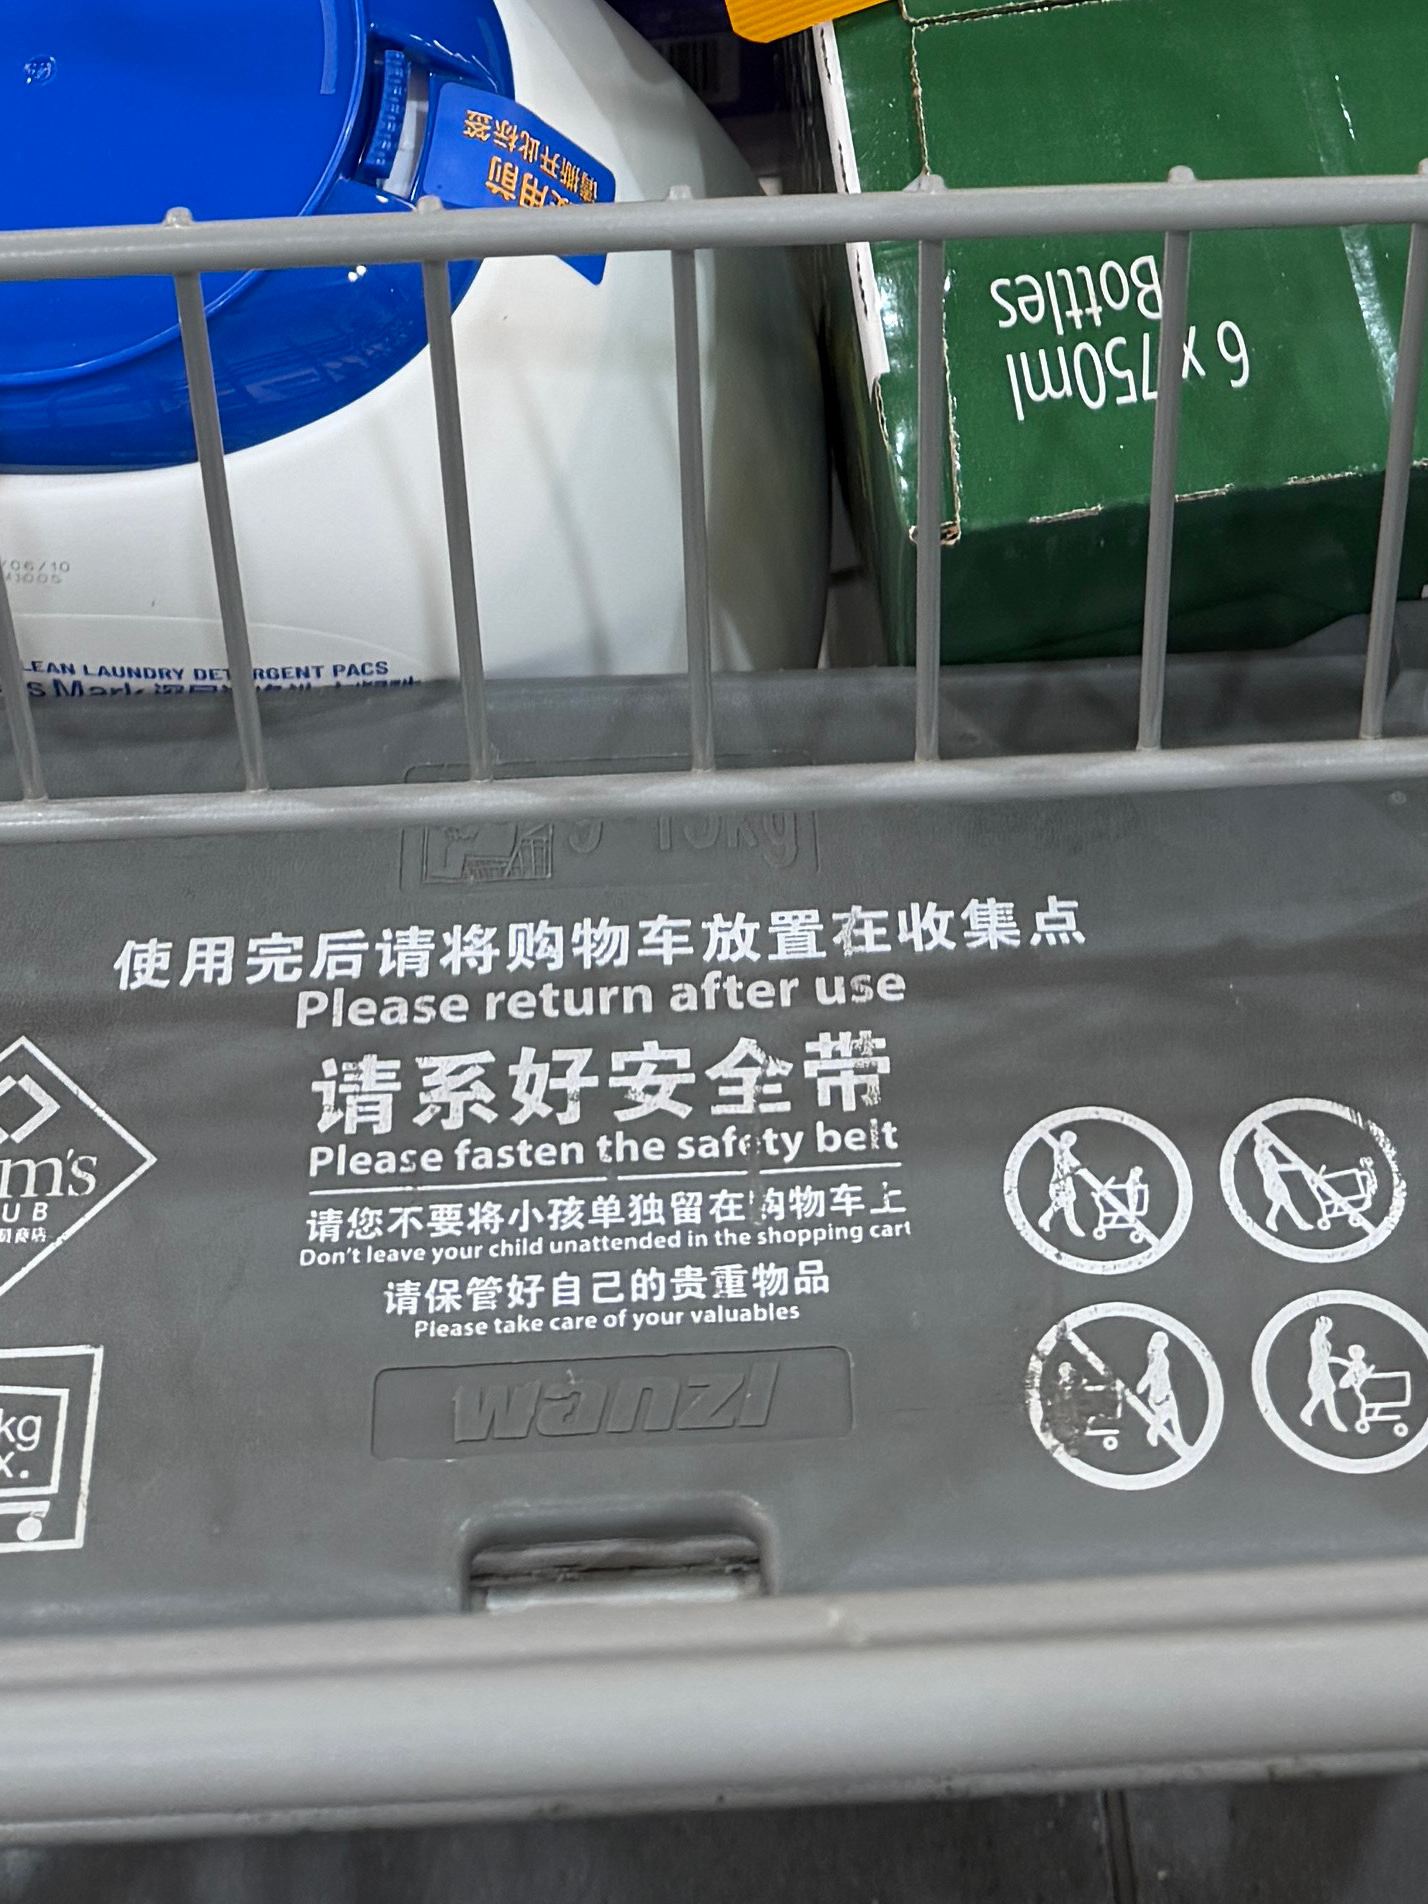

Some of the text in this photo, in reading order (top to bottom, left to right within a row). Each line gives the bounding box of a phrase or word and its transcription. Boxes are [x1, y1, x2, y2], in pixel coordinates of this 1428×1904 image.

[990, 255, 1164, 335] Bottles
[1006, 332, 1159, 421] 750ml
[1217, 320, 1250, 388] 6
[83, 664, 185, 681] LAUNDRY
[193, 663, 325, 682] DETRGENT
[333, 660, 390, 678] PACS
[113, 894, 1088, 992] 使用完后请将购物车放置在收集点
[295, 968, 908, 1031] Please return after use
[310, 1030, 894, 1139] 请系好安全带
[308, 1143, 444, 1178] Please
[454, 1137, 586, 1172] fasten
[596, 1130, 667, 1164] the
[815, 1118, 899, 1154] belt
[299, 1220, 912, 1267] Don't leave your child unattended in the shopping cart
[383, 1259, 830, 1318] 请保管好自己的贵重物品
[415, 1302, 800, 1339] Please take care of your valuables
